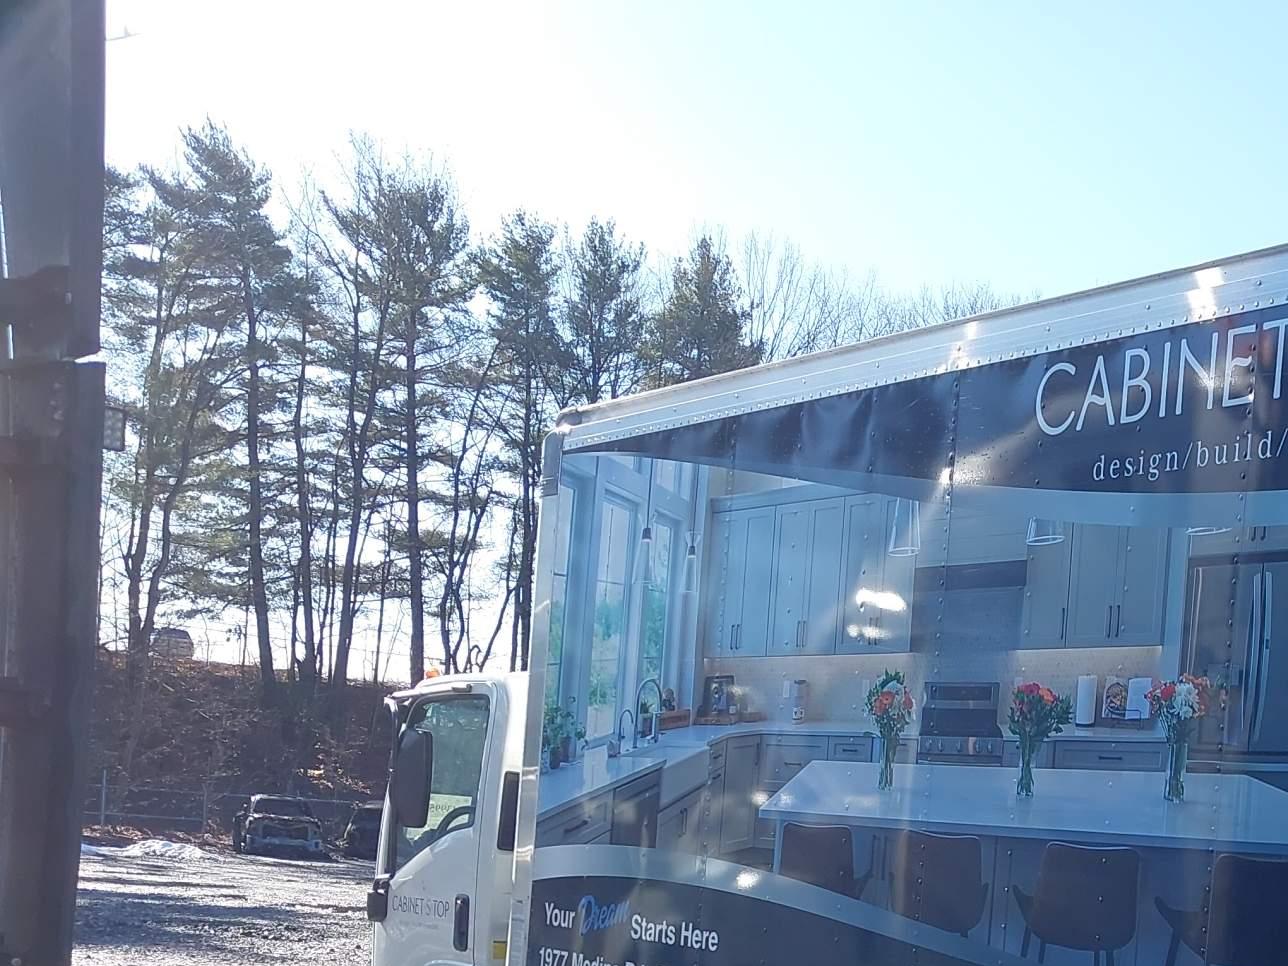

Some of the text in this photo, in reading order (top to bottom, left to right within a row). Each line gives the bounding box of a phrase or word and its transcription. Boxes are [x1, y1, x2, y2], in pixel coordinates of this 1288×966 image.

[544, 894, 720, 953] Your Dream Starts Here
